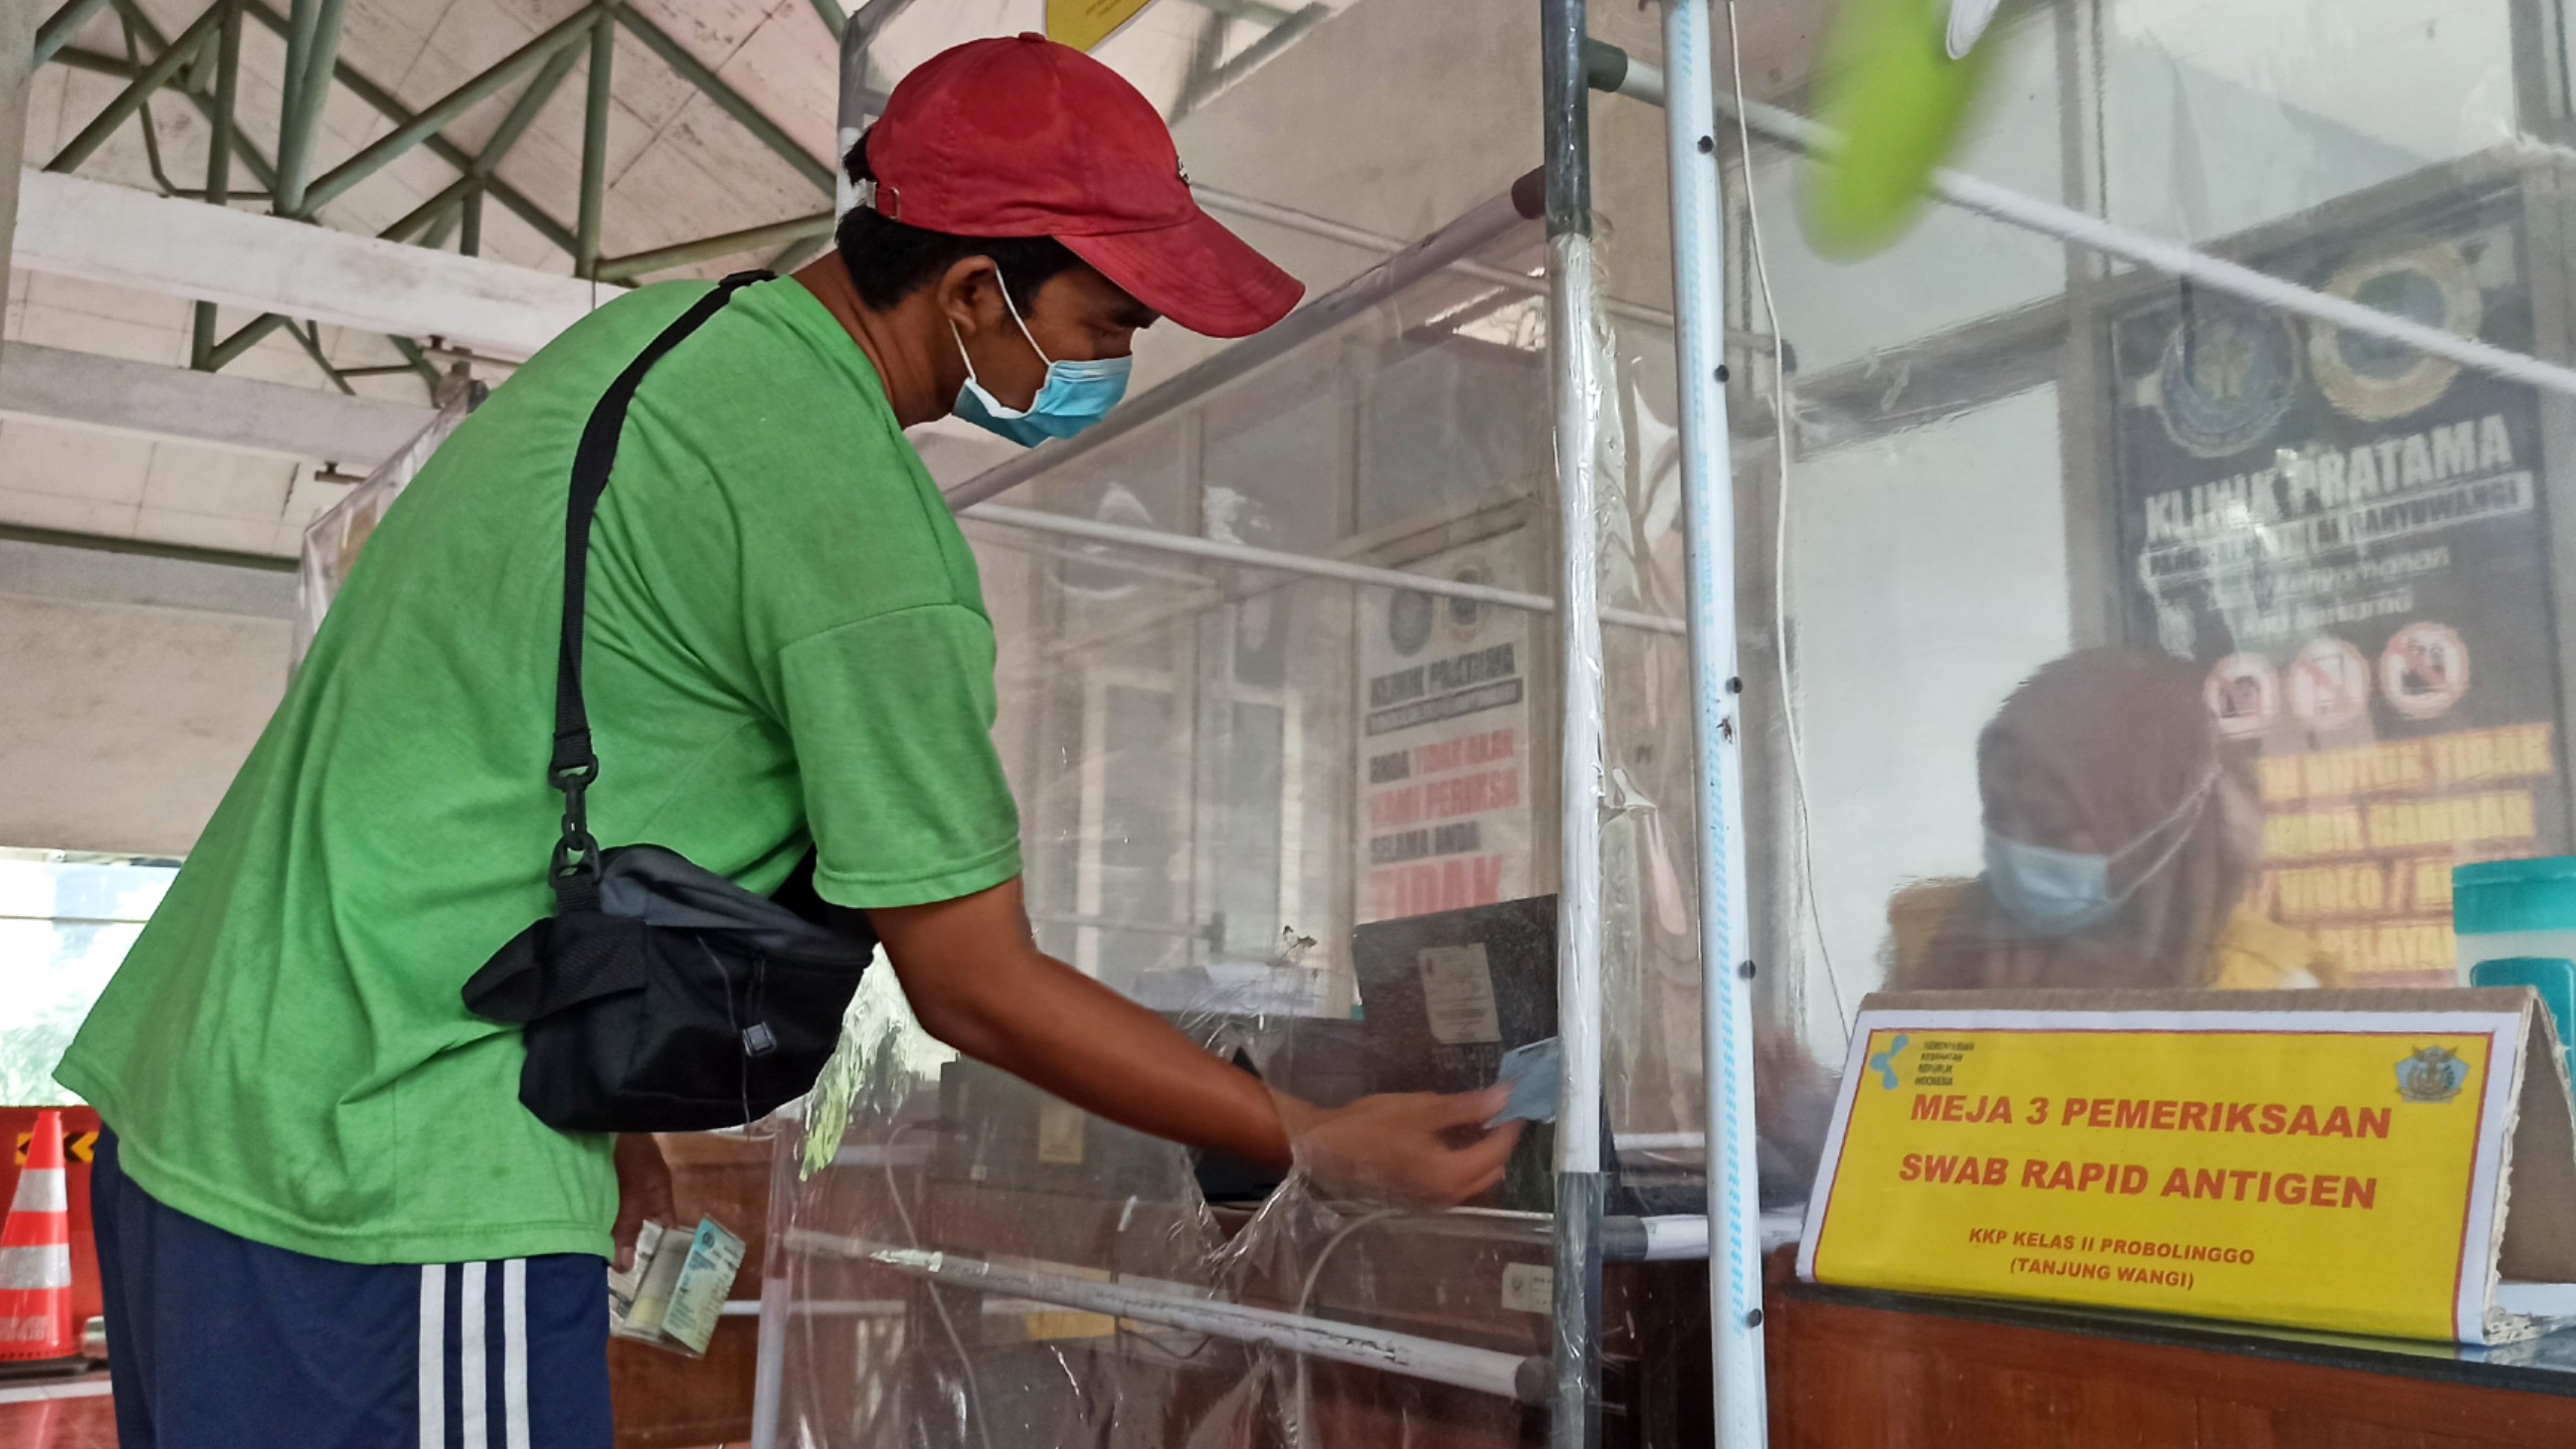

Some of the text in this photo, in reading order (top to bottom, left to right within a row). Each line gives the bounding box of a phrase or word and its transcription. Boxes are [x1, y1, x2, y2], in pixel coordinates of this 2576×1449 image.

[2289, 414, 2511, 512] PRATAMA
[1911, 1094, 2392, 1140] MEJA 3 PEMERIKSAAN
[1899, 1153, 2378, 1210] SWAB RAPID ANTIGEN
[1969, 1228, 2255, 1266] KKP KELAS II PROBOLINGGO
[2010, 1257, 2194, 1291] (TANJUNG WANGI)
